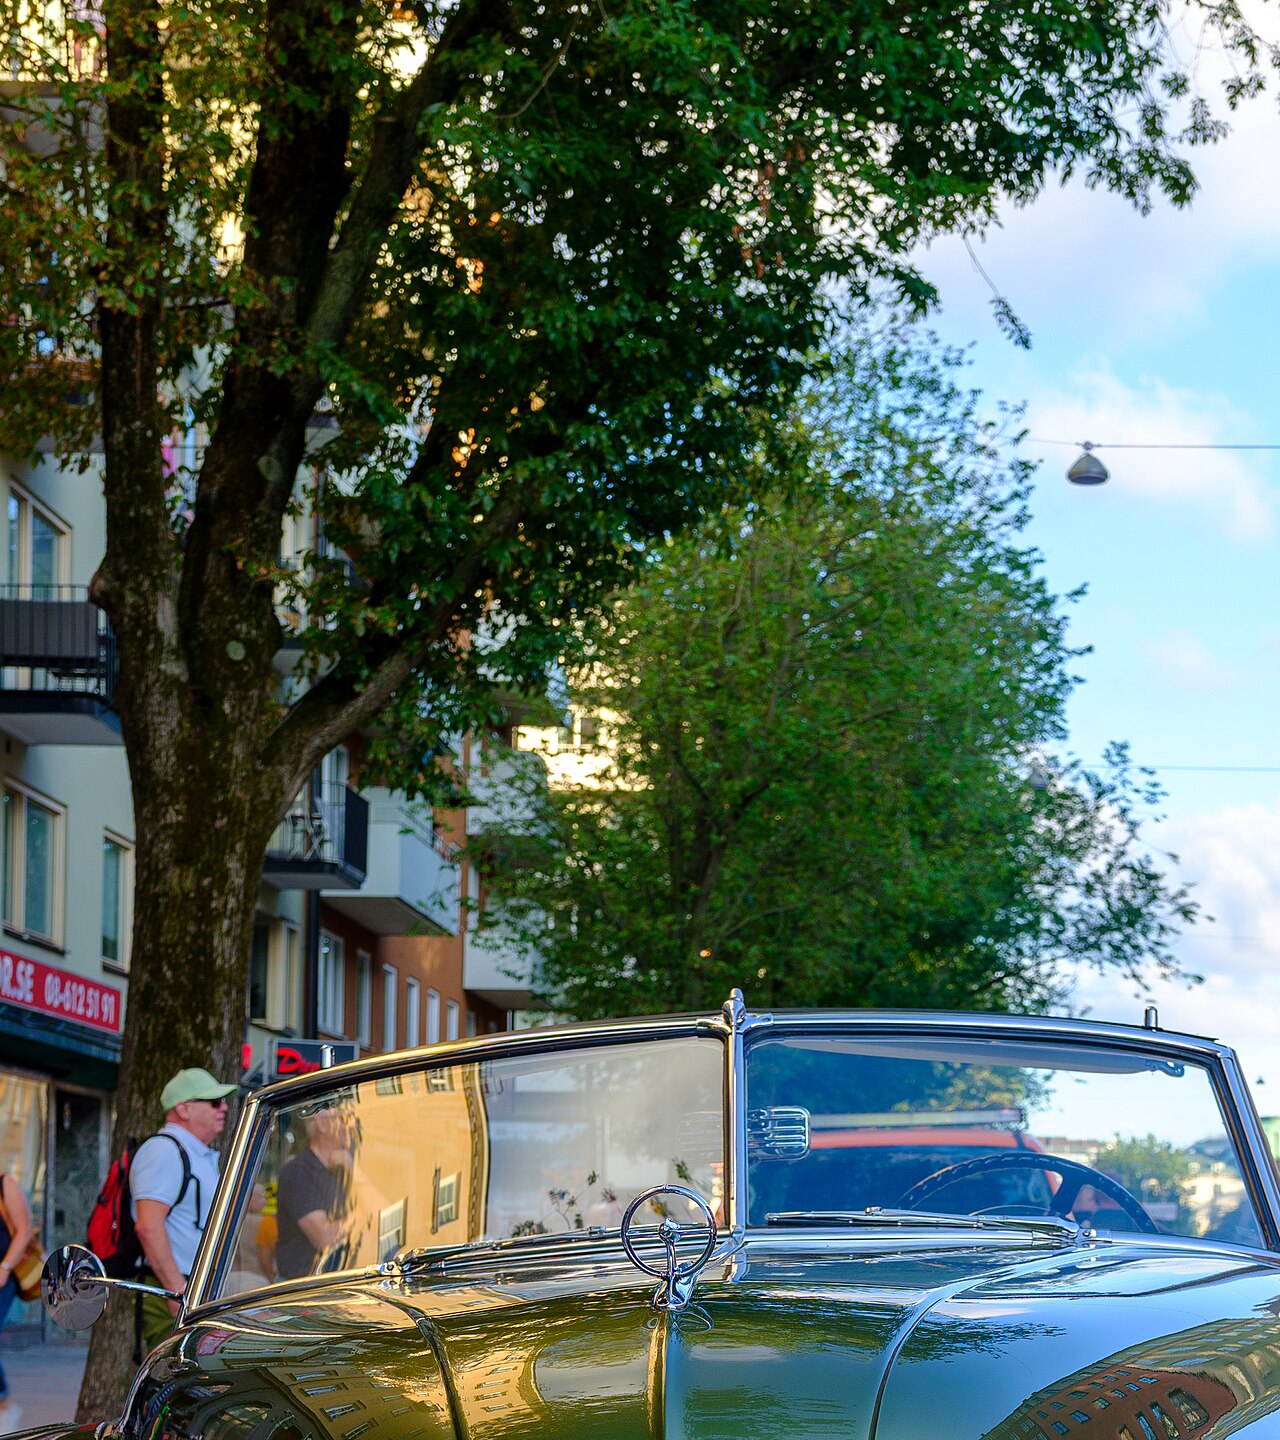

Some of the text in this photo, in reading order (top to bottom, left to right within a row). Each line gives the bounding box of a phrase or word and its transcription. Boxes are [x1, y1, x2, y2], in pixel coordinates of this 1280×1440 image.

[44, 972, 85, 1017] 08-612
[86, 985, 100, 1020] 51
[101, 992, 116, 1025] 91
